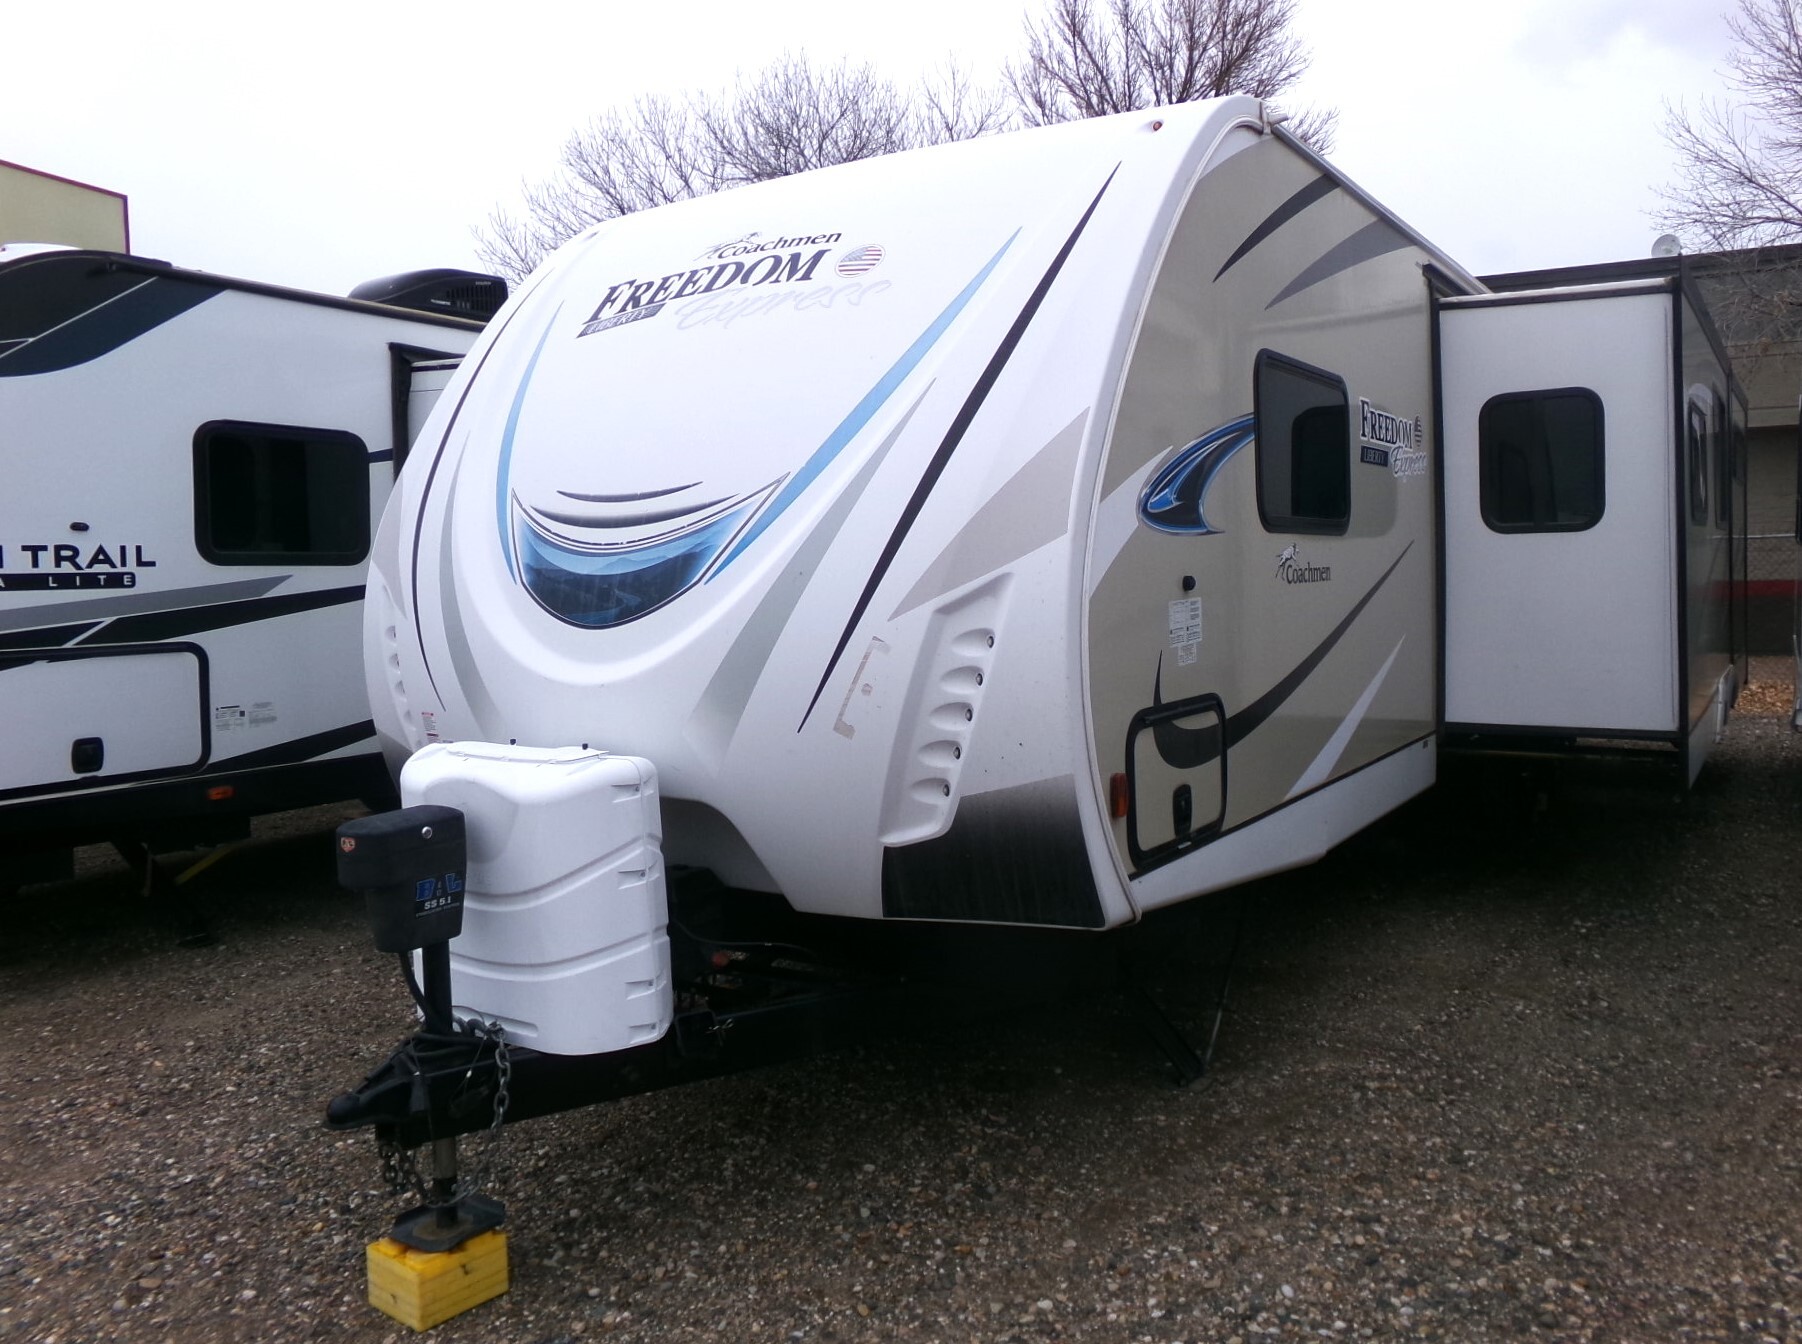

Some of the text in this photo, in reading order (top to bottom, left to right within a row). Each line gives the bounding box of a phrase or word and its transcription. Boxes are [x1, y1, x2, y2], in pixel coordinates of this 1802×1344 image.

[717, 232, 842, 259] Coachmen
[582, 249, 832, 325] FREEDOM
[1360, 398, 1413, 450] FREEDOM
[20, 543, 157, 571] TRAIL
[48, 574, 133, 587] LITE
[1286, 561, 1331, 584] Coachmen
